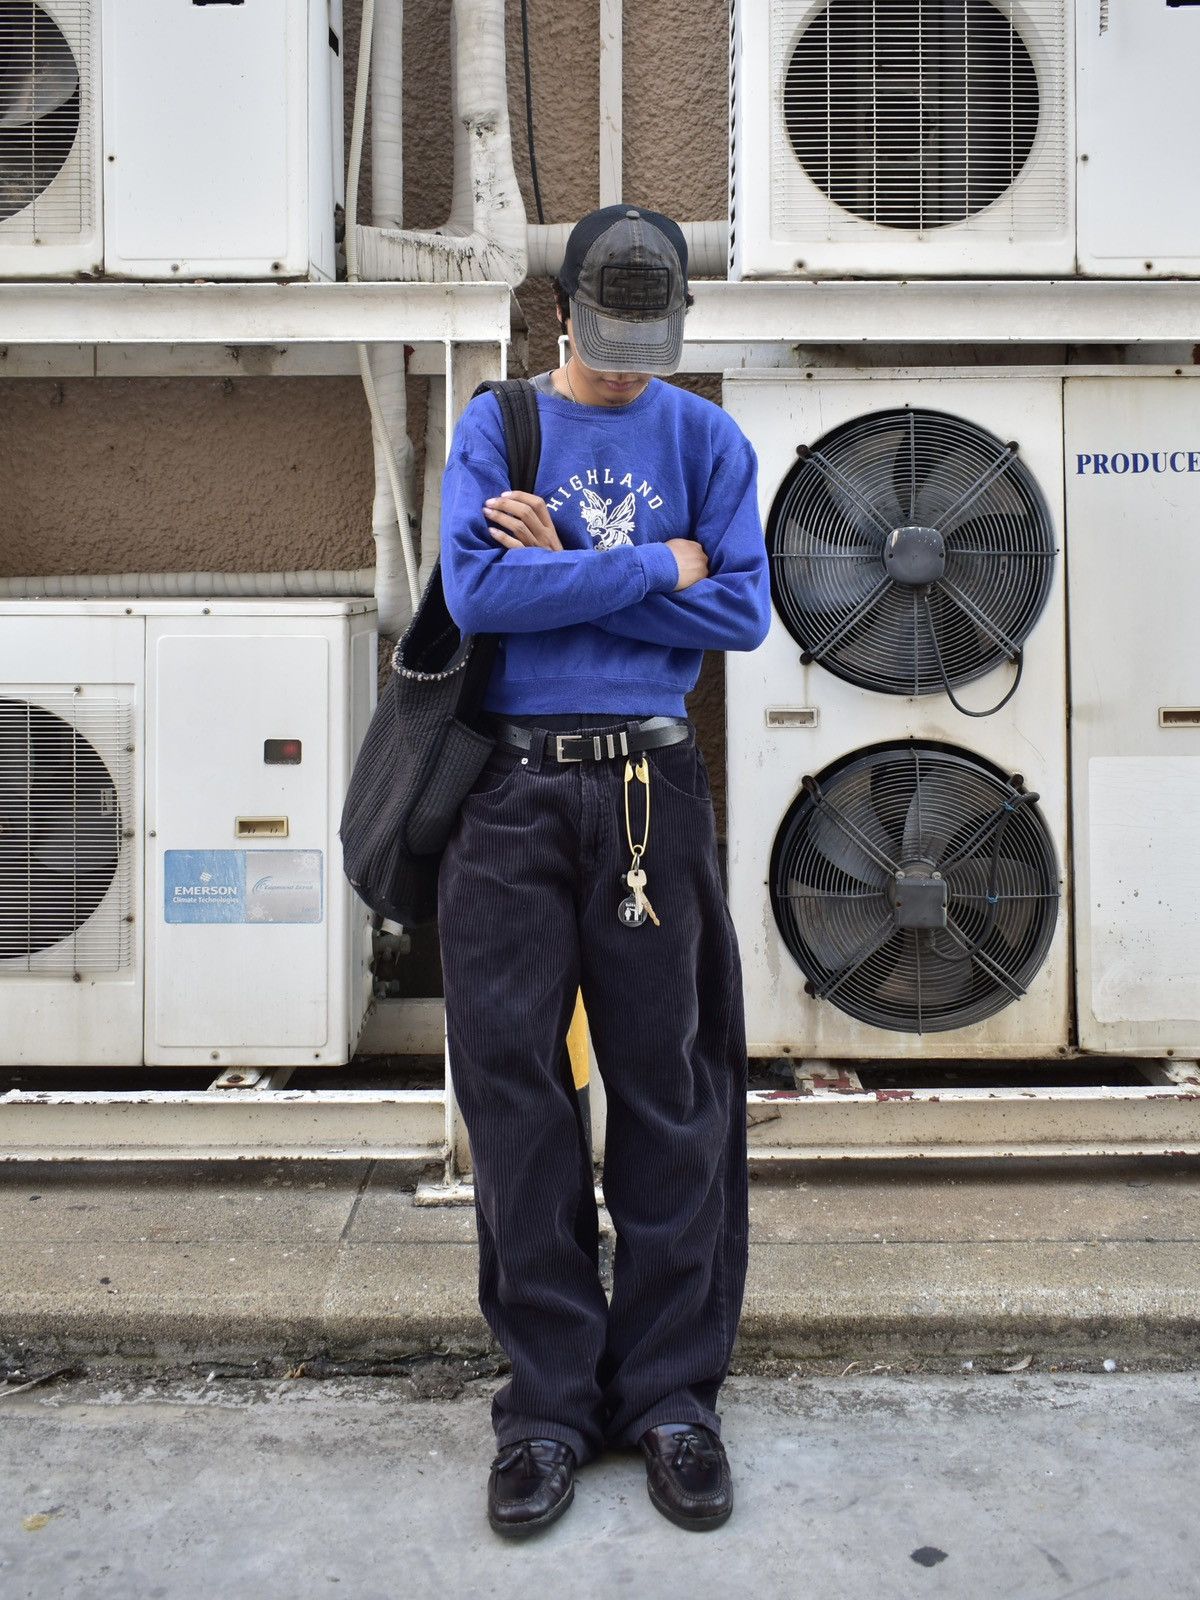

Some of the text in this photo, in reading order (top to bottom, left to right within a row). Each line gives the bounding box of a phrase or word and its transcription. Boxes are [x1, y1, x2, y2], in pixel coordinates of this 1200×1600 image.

[546, 468, 664, 512] HIGHLAND
[174, 886, 238, 896] EMERSON
[198, 896, 239, 905] Technologies
